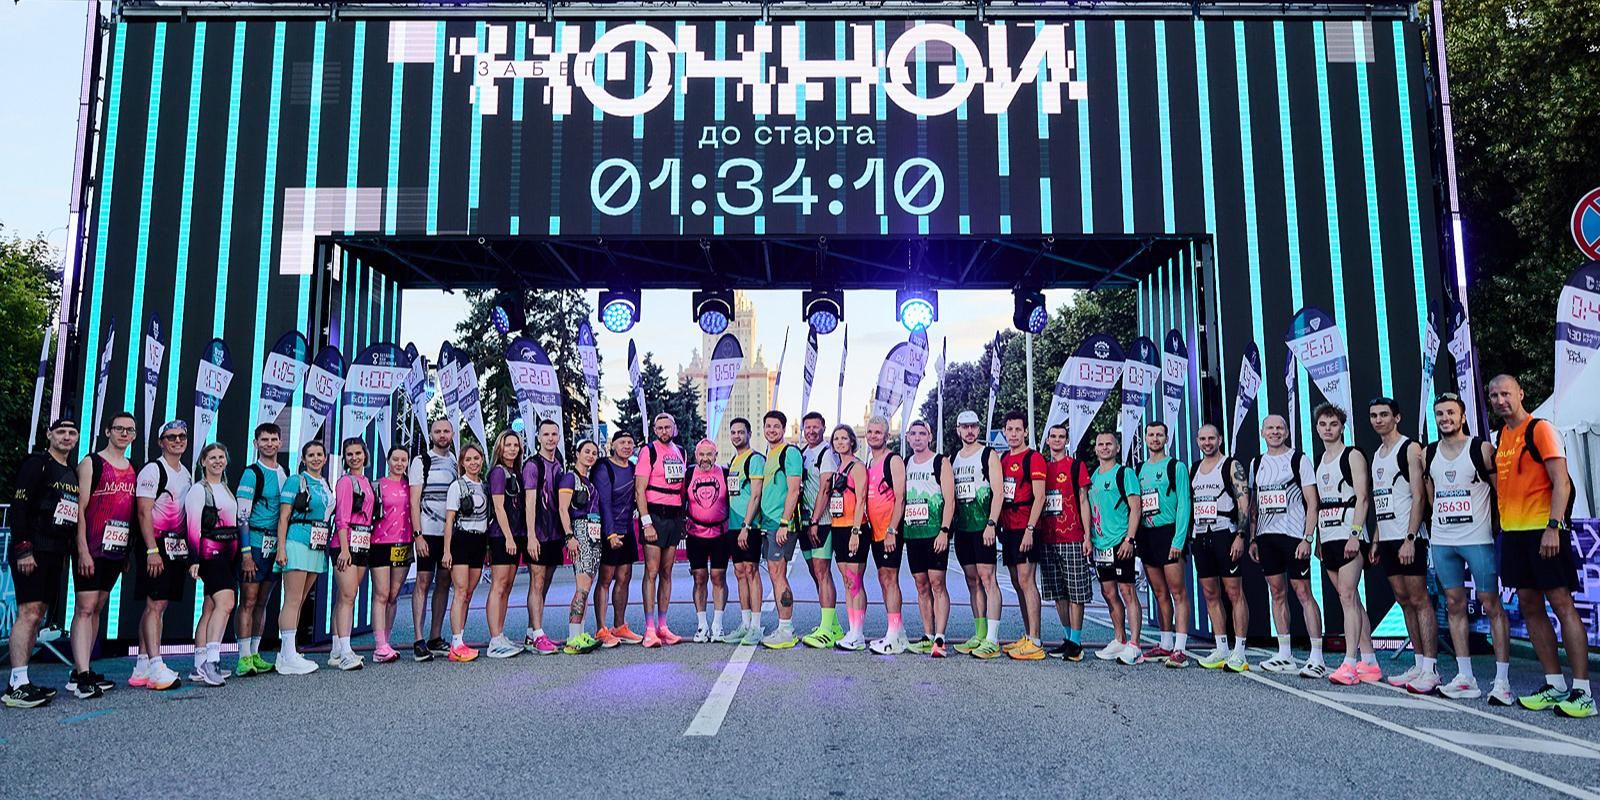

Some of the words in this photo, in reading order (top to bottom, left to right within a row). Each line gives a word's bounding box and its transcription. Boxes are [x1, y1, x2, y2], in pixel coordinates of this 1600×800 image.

[699, 126, 741, 149] до
[754, 125, 876, 150] старта
[590, 157, 945, 216] 01:34:10
[360, 370, 394, 389] 1:00
[715, 363, 735, 381] 0:50
[1080, 363, 1114, 383] 0:39
[1260, 494, 1285, 504] 25618
[1437, 501, 1471, 512] 25630
[906, 507, 928, 517] 25640
